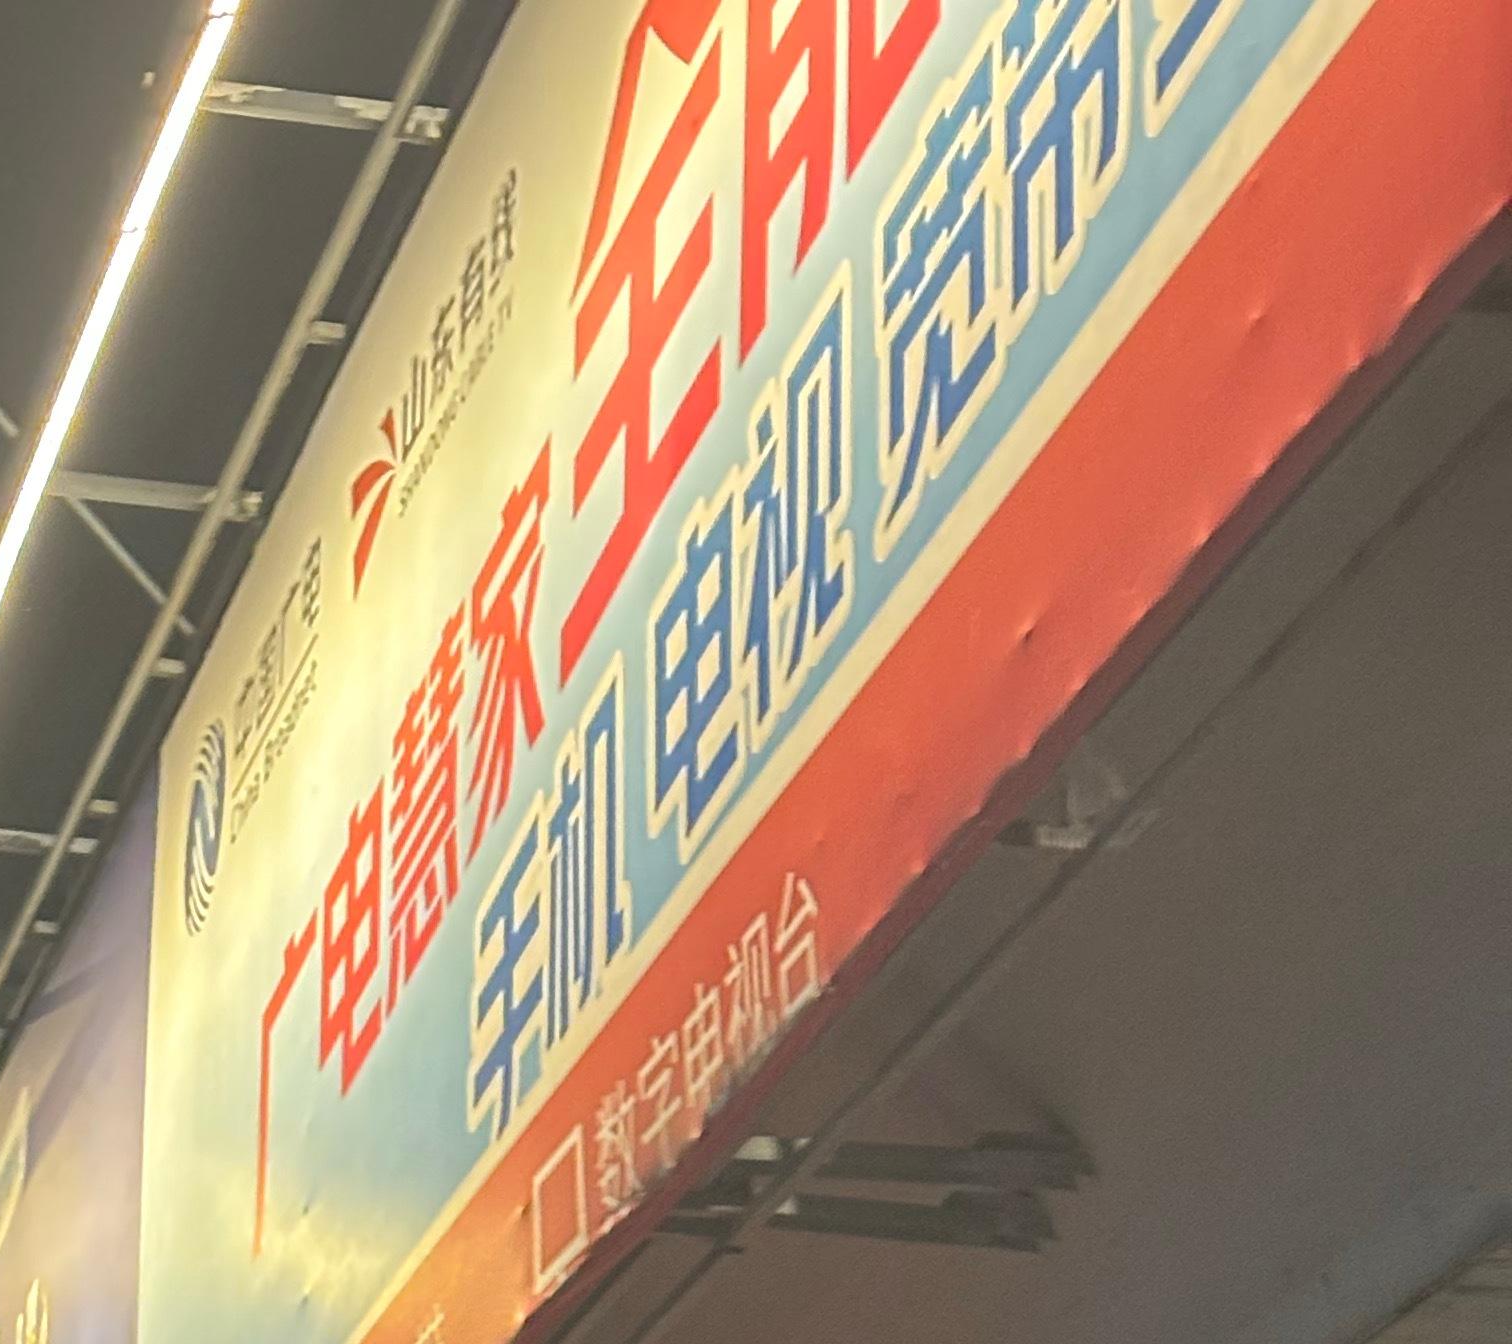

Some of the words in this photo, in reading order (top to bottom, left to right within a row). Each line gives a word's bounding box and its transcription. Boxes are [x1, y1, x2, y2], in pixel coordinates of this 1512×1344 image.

[402, 167, 516, 463] 山东有线
[473, 685, 628, 1130] 手机
[652, 293, 847, 842] 电视
[883, 0, 1124, 524] 宽带
[251, 435, 550, 1258] 广电慧家
